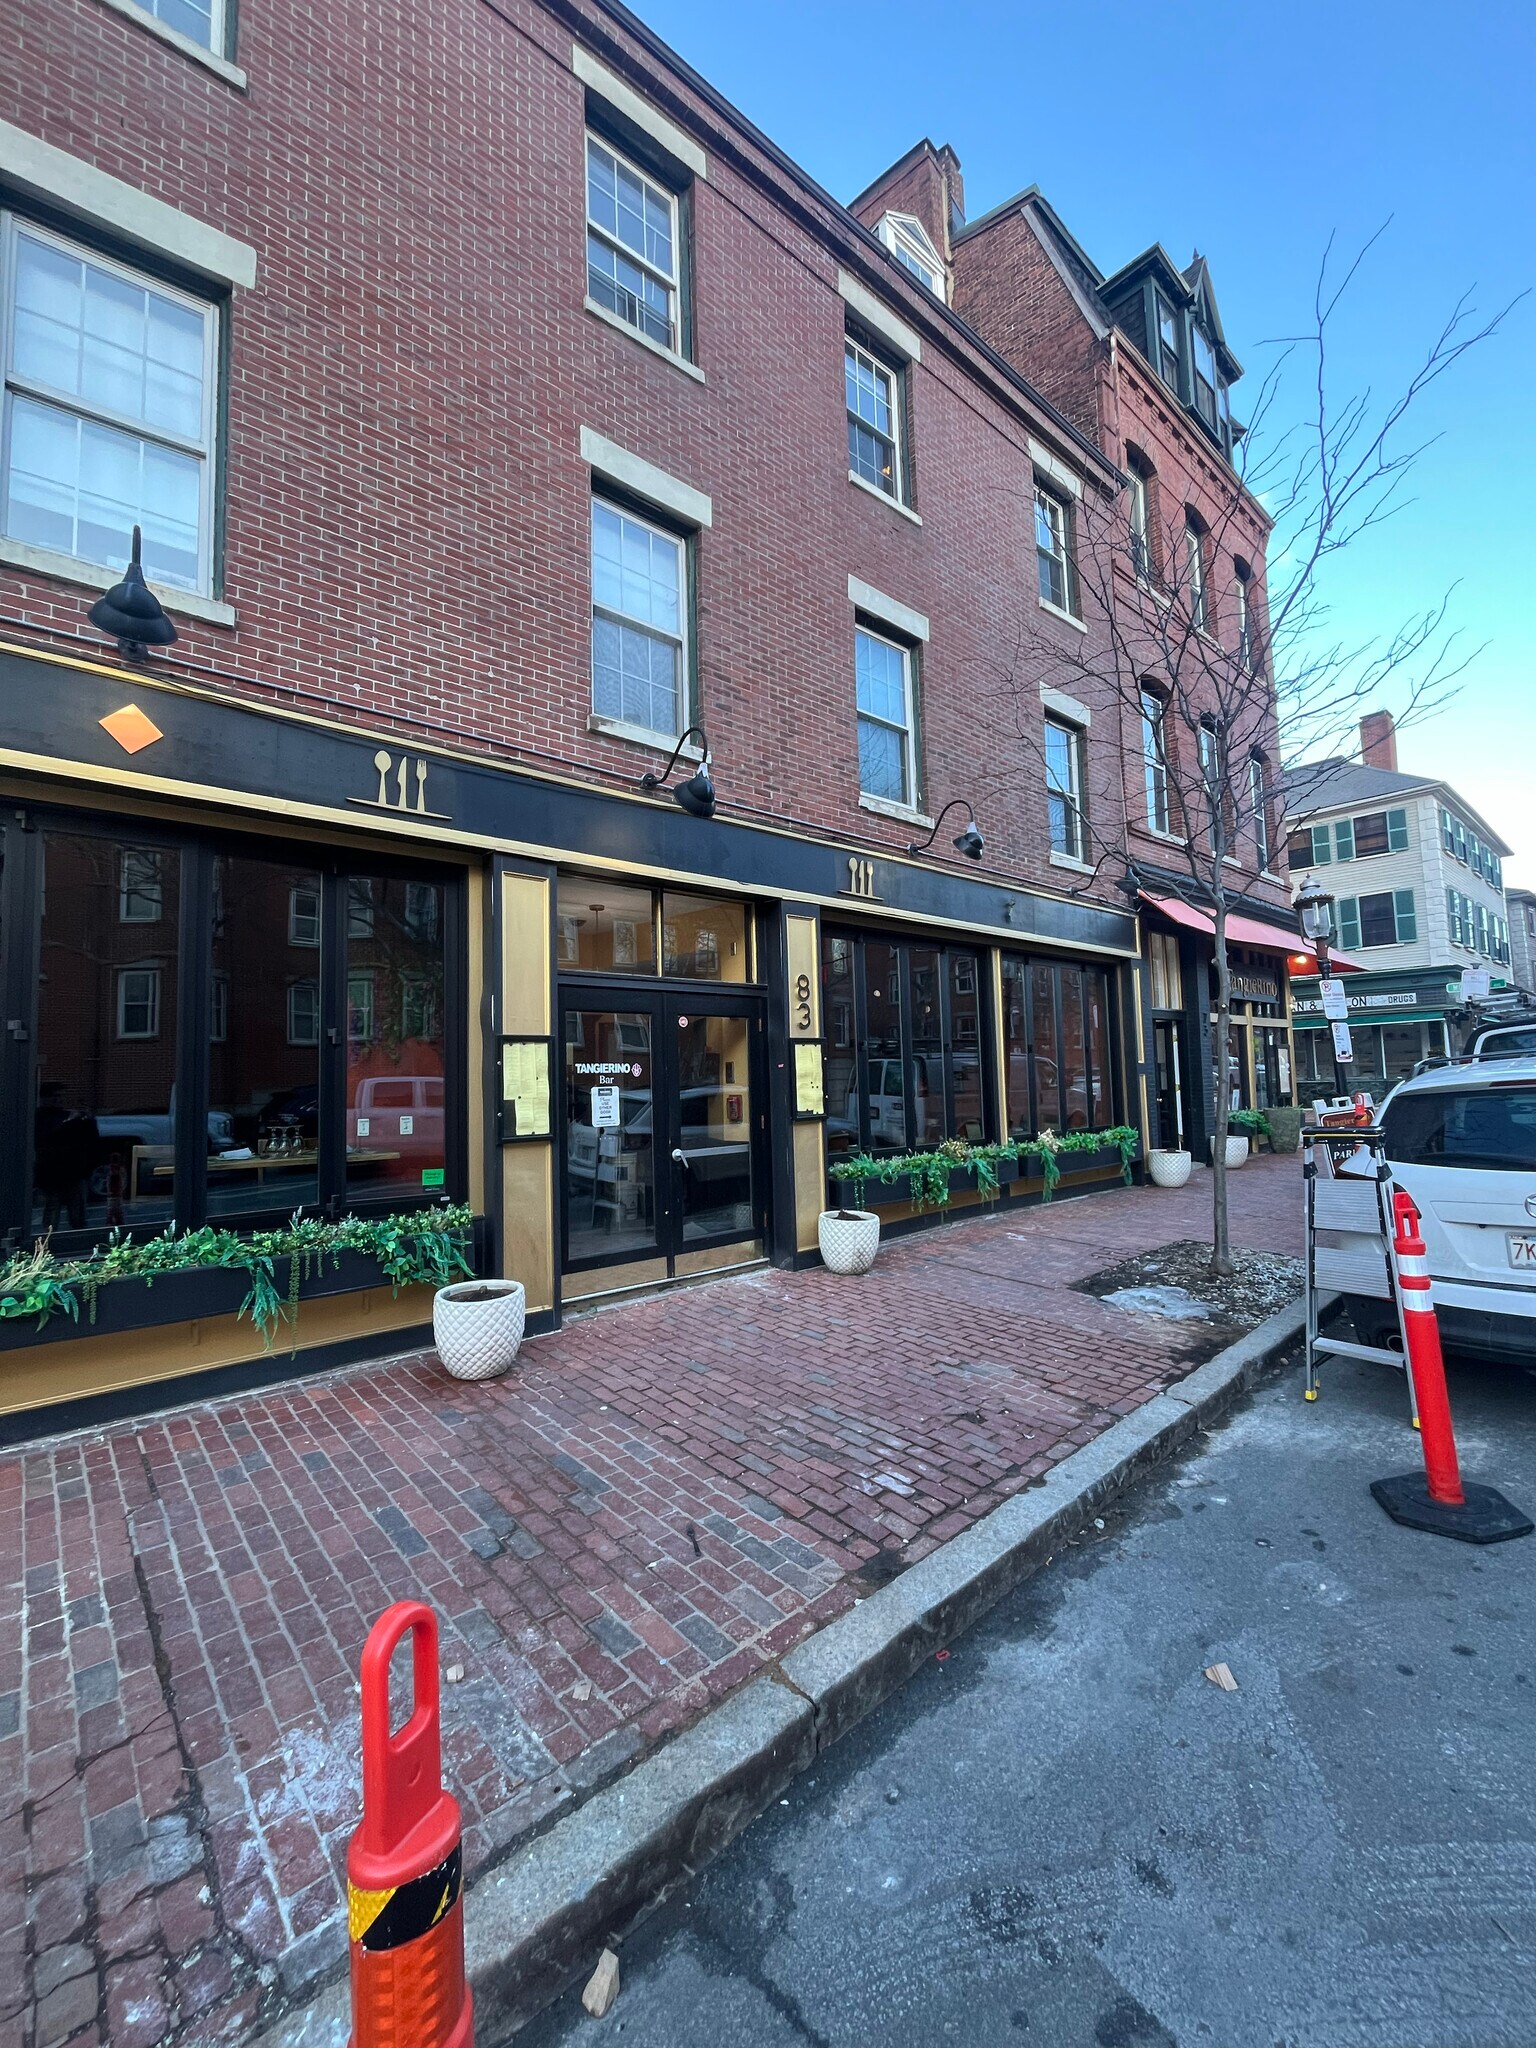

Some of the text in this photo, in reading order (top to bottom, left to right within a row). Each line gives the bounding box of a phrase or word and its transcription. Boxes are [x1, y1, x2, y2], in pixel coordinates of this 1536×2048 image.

[797, 974, 811, 1030] 83
[1309, 1000, 1317, 1010] &
[1347, 997, 1367, 1008] ON
[1388, 995, 1414, 1004] DRUGS
[574, 1063, 631, 1074] TANGIERINO
[599, 1075, 614, 1084] Bar
